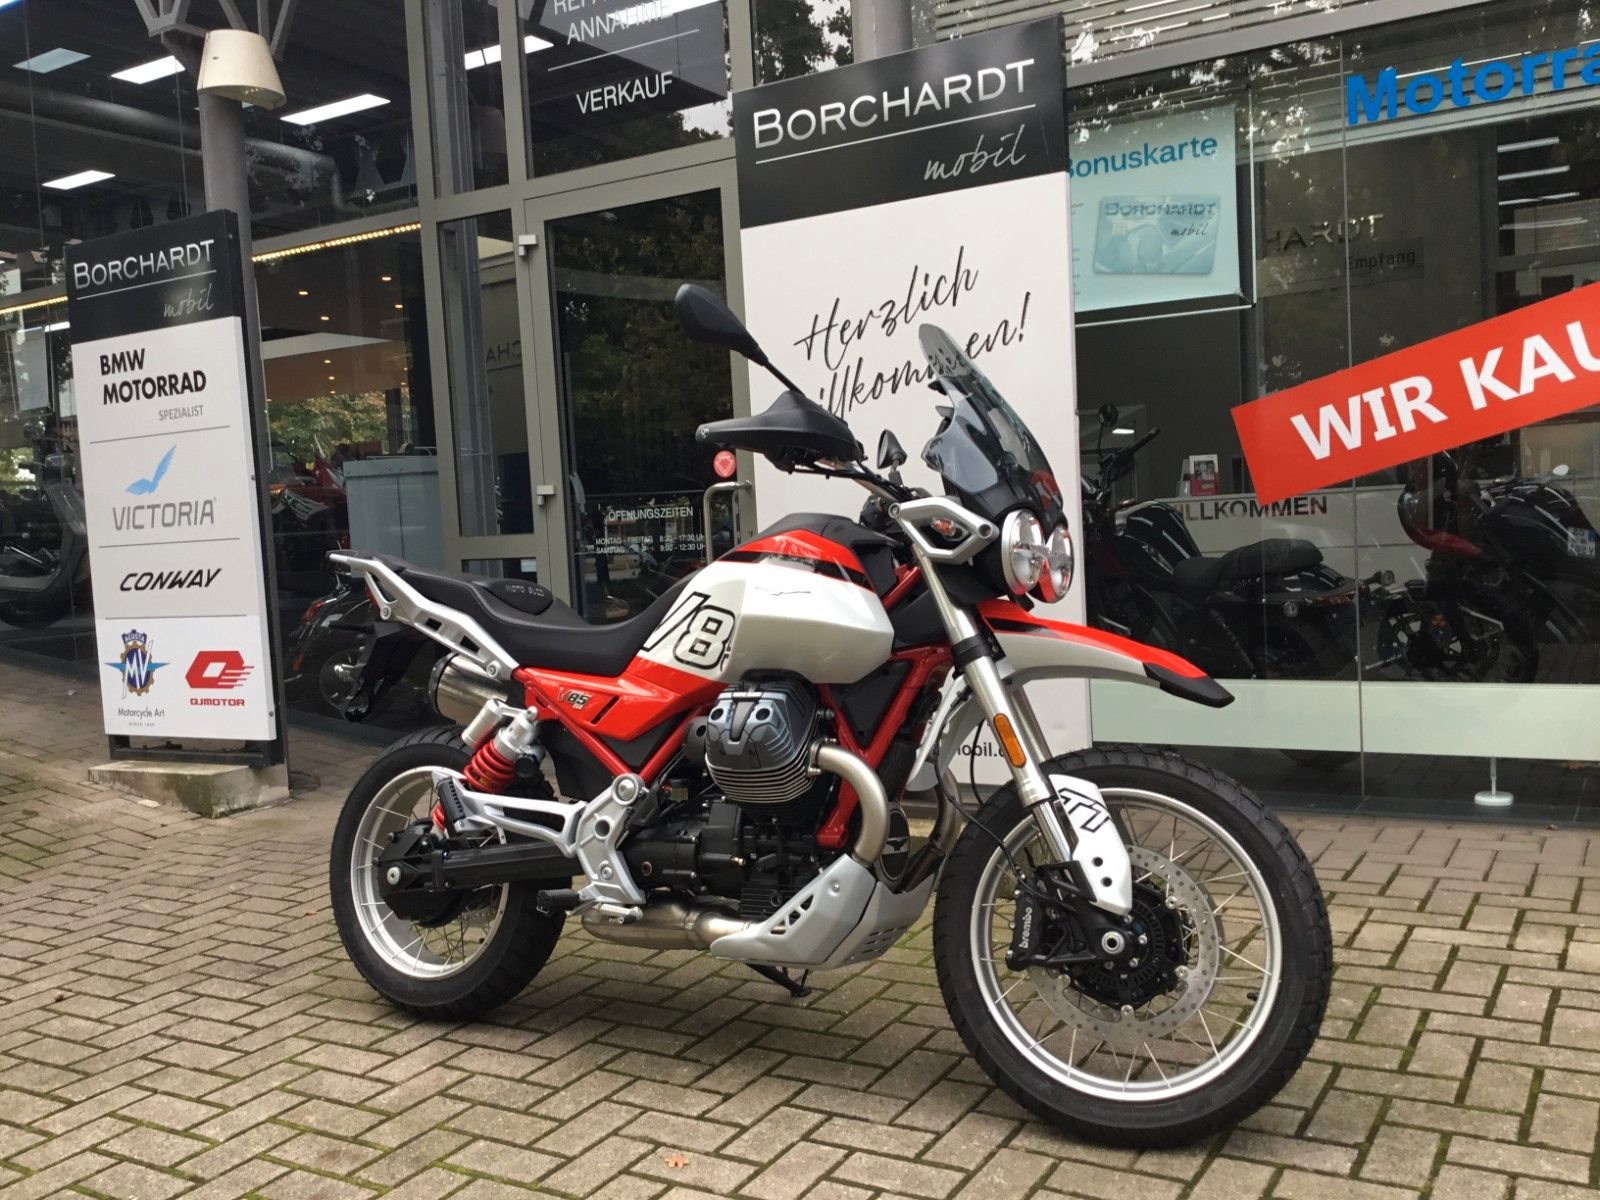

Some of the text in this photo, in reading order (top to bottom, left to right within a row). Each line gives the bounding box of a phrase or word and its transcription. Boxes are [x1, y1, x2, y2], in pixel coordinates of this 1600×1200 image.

[566, 1, 673, 45] ANNAHME
[576, 70, 673, 115] VERKAUF
[753, 58, 1035, 149] BORCHARDT
[923, 123, 1027, 181] mobil
[1169, 222, 1209, 237] mobil
[73, 239, 215, 290] BORCHARDT
[163, 282, 215, 318] mobil
[793, 245, 979, 370] Herzlich
[100, 348, 145, 376] BMW
[103, 369, 207, 405] MOTORRAD
[158, 404, 205, 422] SPEZIALIST
[1289, 375, 1449, 461] WIR
[112, 499, 215, 531] VICTORIA
[120, 568, 222, 592] CONWAY
[123, 632, 146, 644] AGUSTA
[118, 706, 165, 719] Motorcycle Art
[190, 697, 246, 707] QJMOTOR
[1019, 906, 1033, 949] brembo
